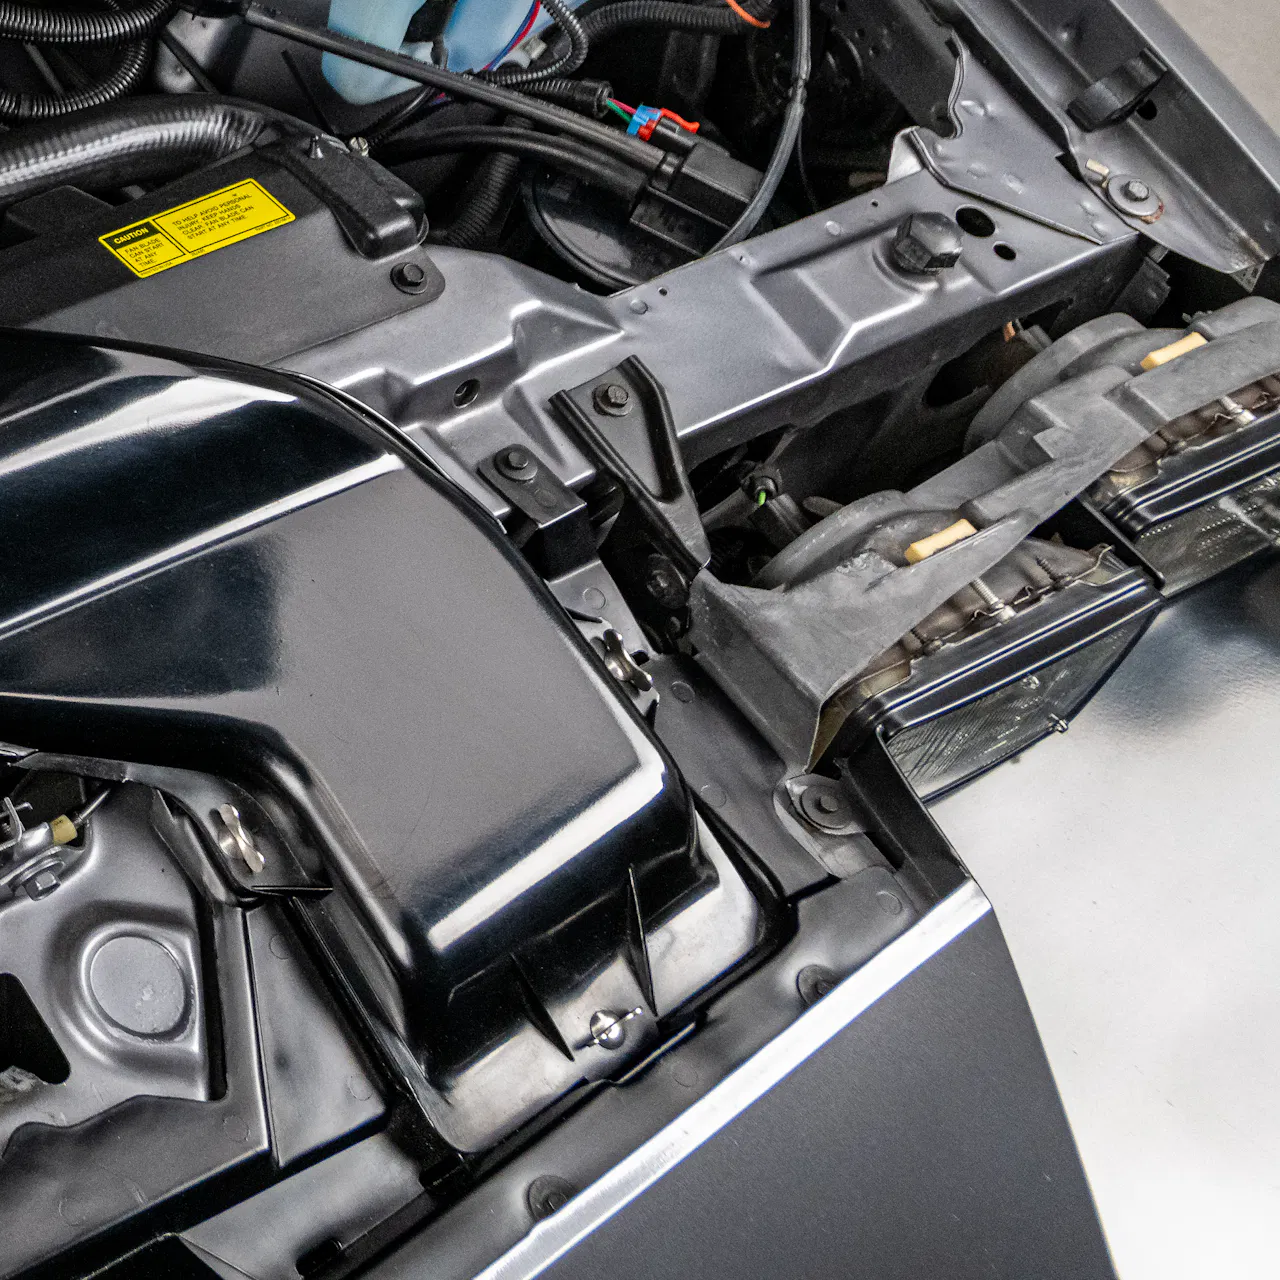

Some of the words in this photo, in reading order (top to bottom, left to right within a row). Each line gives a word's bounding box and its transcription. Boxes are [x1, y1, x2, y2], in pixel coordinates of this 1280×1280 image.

[172, 219, 182, 227] TO
[182, 212, 199, 223] HELP
[199, 204, 219, 216] AVOID
[219, 193, 253, 209] PERSONAL
[202, 213, 217, 224] KEEP
[217, 204, 241, 216] HANDS
[206, 218, 218, 228] FAN
[219, 210, 240, 223] BLADE
[240, 204, 255, 214] CAN
[113, 227, 150, 246] CAUTION
[187, 229, 208, 241] START
[217, 220, 231, 230] ANY
[124, 245, 138, 255] FAN
[138, 237, 161, 250] BLADE
[129, 249, 143, 259] CAN
[143, 241, 165, 254] START
[134, 255, 145, 264] AT
[145, 250, 158, 260] ANY
